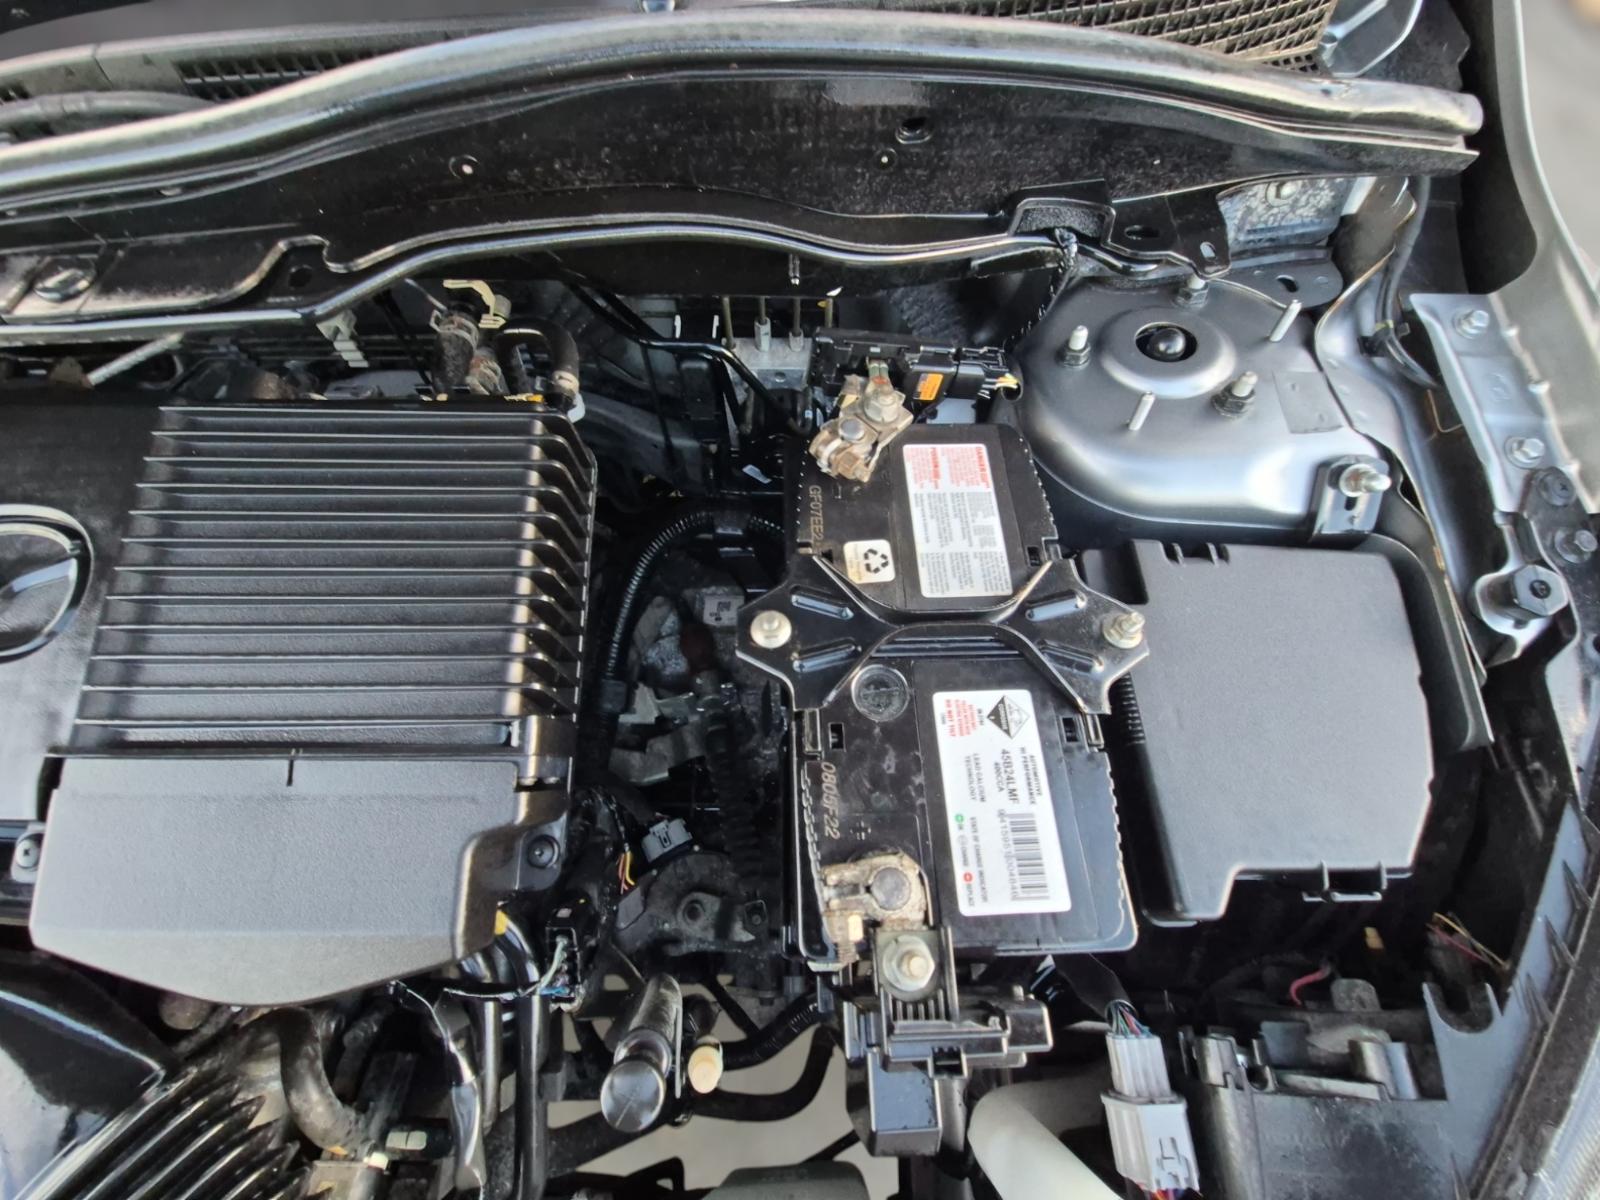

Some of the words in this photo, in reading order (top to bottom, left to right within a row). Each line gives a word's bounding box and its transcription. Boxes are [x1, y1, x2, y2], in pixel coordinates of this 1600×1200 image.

[964, 755, 978, 801] TECHNOLOGY
[994, 762, 1004, 792] 400CCA
[1001, 749, 1019, 804] 45B24LMF
[1021, 756, 1036, 805] PERFORMANCE
[1029, 754, 1042, 796] AUTOMOTIVE
[822, 761, 840, 840] 0805F22
